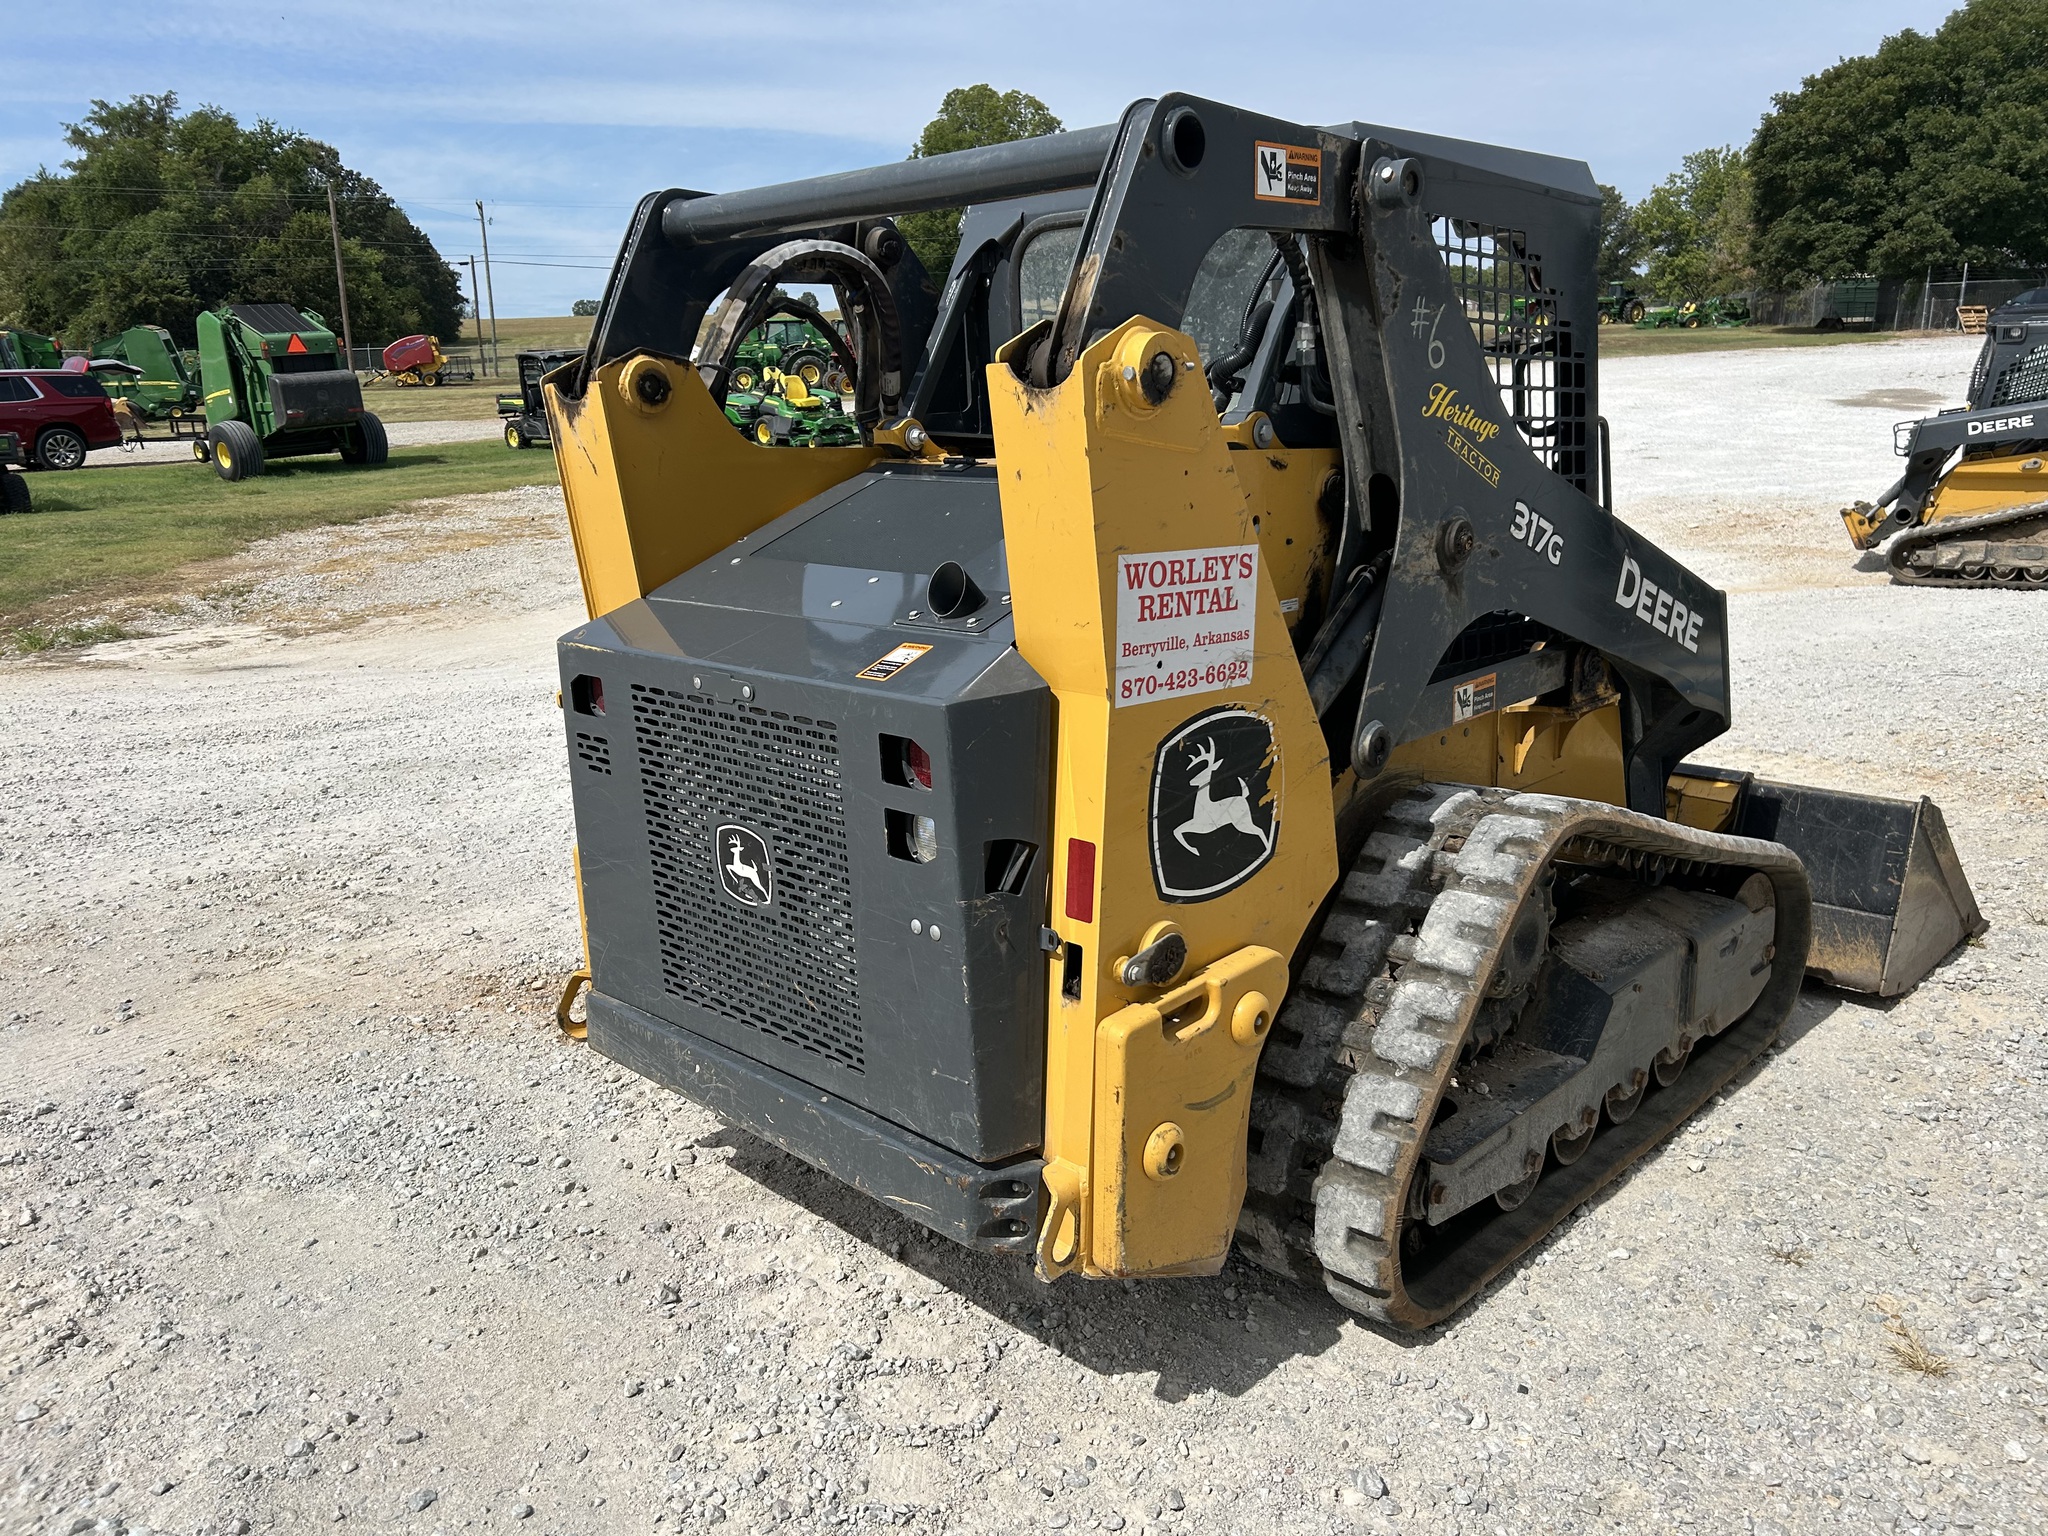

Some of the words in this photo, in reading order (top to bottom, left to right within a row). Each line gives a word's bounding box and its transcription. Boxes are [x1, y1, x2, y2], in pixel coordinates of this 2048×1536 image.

[1294, 152, 1318, 162] WARNING
[1288, 171, 1303, 180] Pinch
[1304, 173, 1316, 182] Area
[1300, 185, 1312, 194] Away
[1421, 382, 1500, 442] Heritage
[1967, 414, 2034, 436] DEERE
[1447, 429, 1500, 485] TRACTOR
[1510, 501, 1564, 565] 317G
[1124, 553, 1253, 590] WORLEY'S
[1137, 586, 1239, 622] RENTAL
[1615, 554, 1704, 654] DEERE
[1122, 636, 1189, 657] Berryville,
[1193, 629, 1250, 647] Arkansas
[1121, 660, 1248, 699] 870-423-6622
